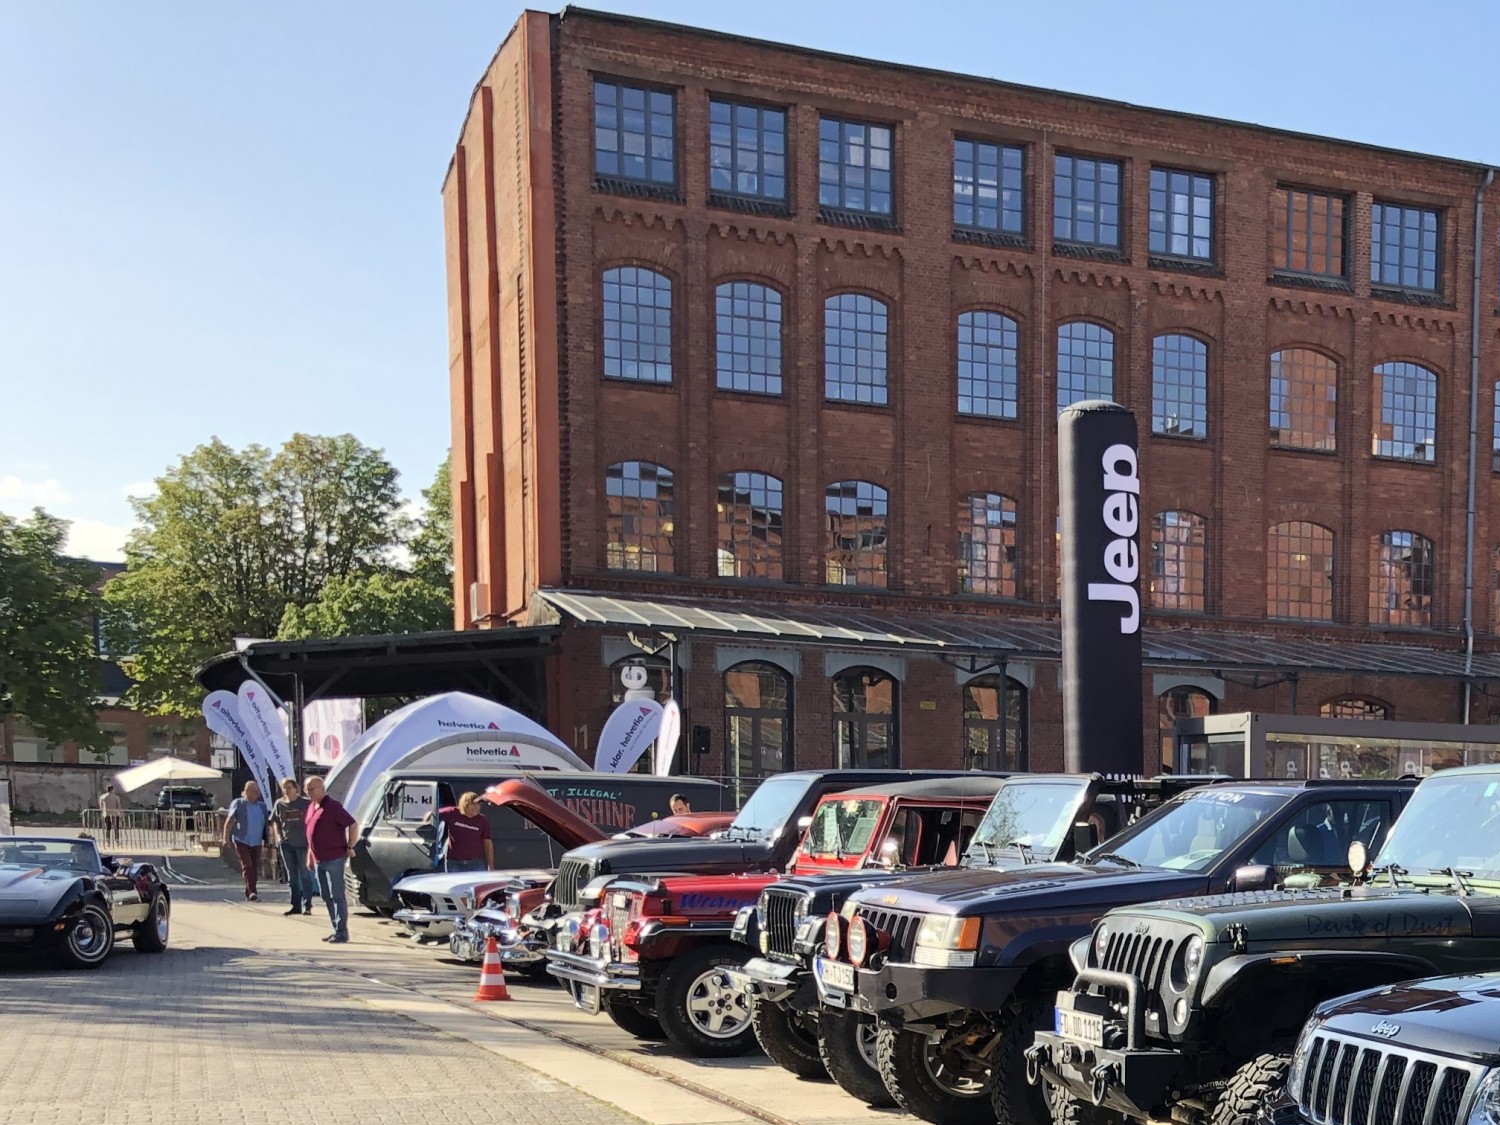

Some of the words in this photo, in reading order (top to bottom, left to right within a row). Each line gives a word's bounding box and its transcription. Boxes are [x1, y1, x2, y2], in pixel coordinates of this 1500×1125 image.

[1088, 443, 1140, 634] Jeep
[438, 719, 486, 729] helvetia
[620, 715, 645, 748] helvetia
[466, 746, 508, 756] helvetia
[566, 788, 617, 800] ILLEGAL
[1370, 1020, 1400, 1037] Jeep
[1198, 1080, 1229, 1090] ANTIROC
